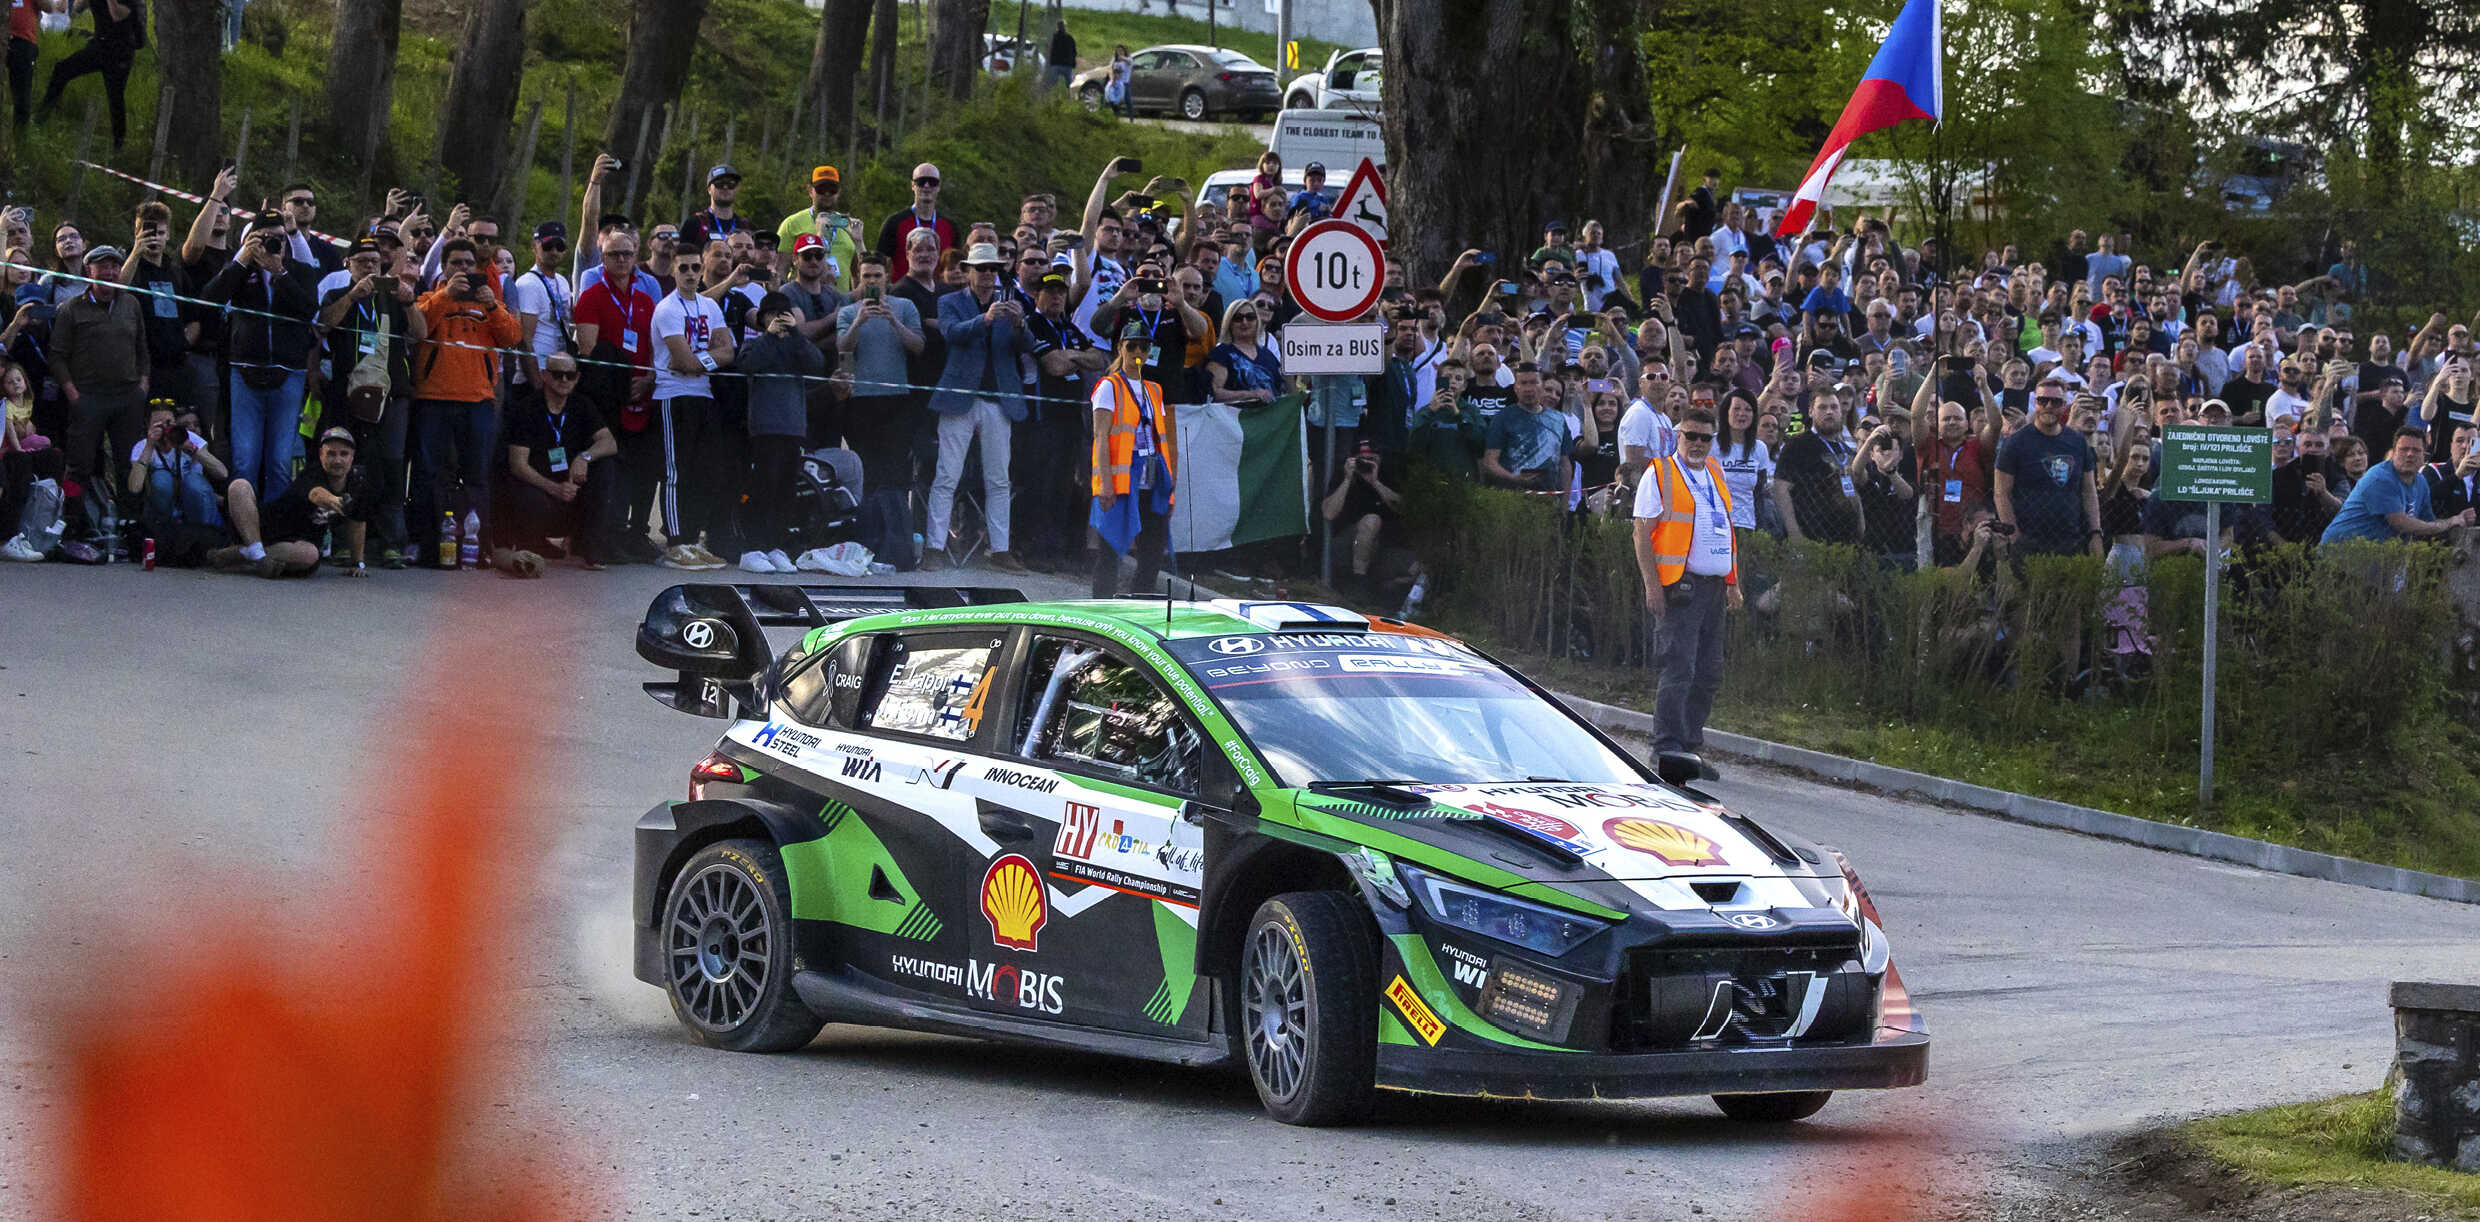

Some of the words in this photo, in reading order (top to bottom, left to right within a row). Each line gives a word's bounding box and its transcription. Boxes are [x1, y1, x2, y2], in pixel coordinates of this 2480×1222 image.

[1285, 126, 1301, 136] THE
[1303, 127, 1339, 138] CLOSEST
[1342, 129, 1364, 139] TEAM
[1367, 131, 1377, 140] TO
[1314, 251, 1347, 290] 10
[1353, 264, 1361, 290] t
[1286, 340, 1322, 357] Osim
[1326, 344, 1343, 357] za
[1350, 339, 1379, 357] BUS
[1010, 612, 1029, 622] you
[1056, 613, 1095, 628] because
[1094, 621, 1114, 633] only
[1111, 628, 1129, 640] you
[1128, 635, 1151, 653] know
[1146, 649, 1167, 668] your
[1162, 662, 1177, 681] true
[1268, 633, 1398, 650] HYUNDAI
[835, 673, 862, 689] CRAIG
[1206, 659, 1331, 679] BEYOND
[961, 665, 997, 732] 4
[770, 738, 800, 759] STEEL
[779, 725, 821, 749] HYUNDAI
[836, 742, 873, 757] HYUNDAI
[841, 756, 881, 783] WIA
[1224, 739, 1261, 787] #ForCraig
[983, 766, 1060, 795] INNOCEAN
[1478, 785, 1604, 798] HYUNDAI
[1538, 792, 1703, 814] MOBIS
[1074, 864, 1086, 876] FIA
[1086, 866, 1106, 881] World
[1106, 872, 1123, 885] Rally
[1123, 875, 1167, 896] Championship
[1441, 943, 1488, 968] HYUNDAI
[892, 954, 963, 986] HYUNDAI
[966, 958, 1064, 1015] MOBIS
[1393, 983, 1439, 1038] PIRELLI
